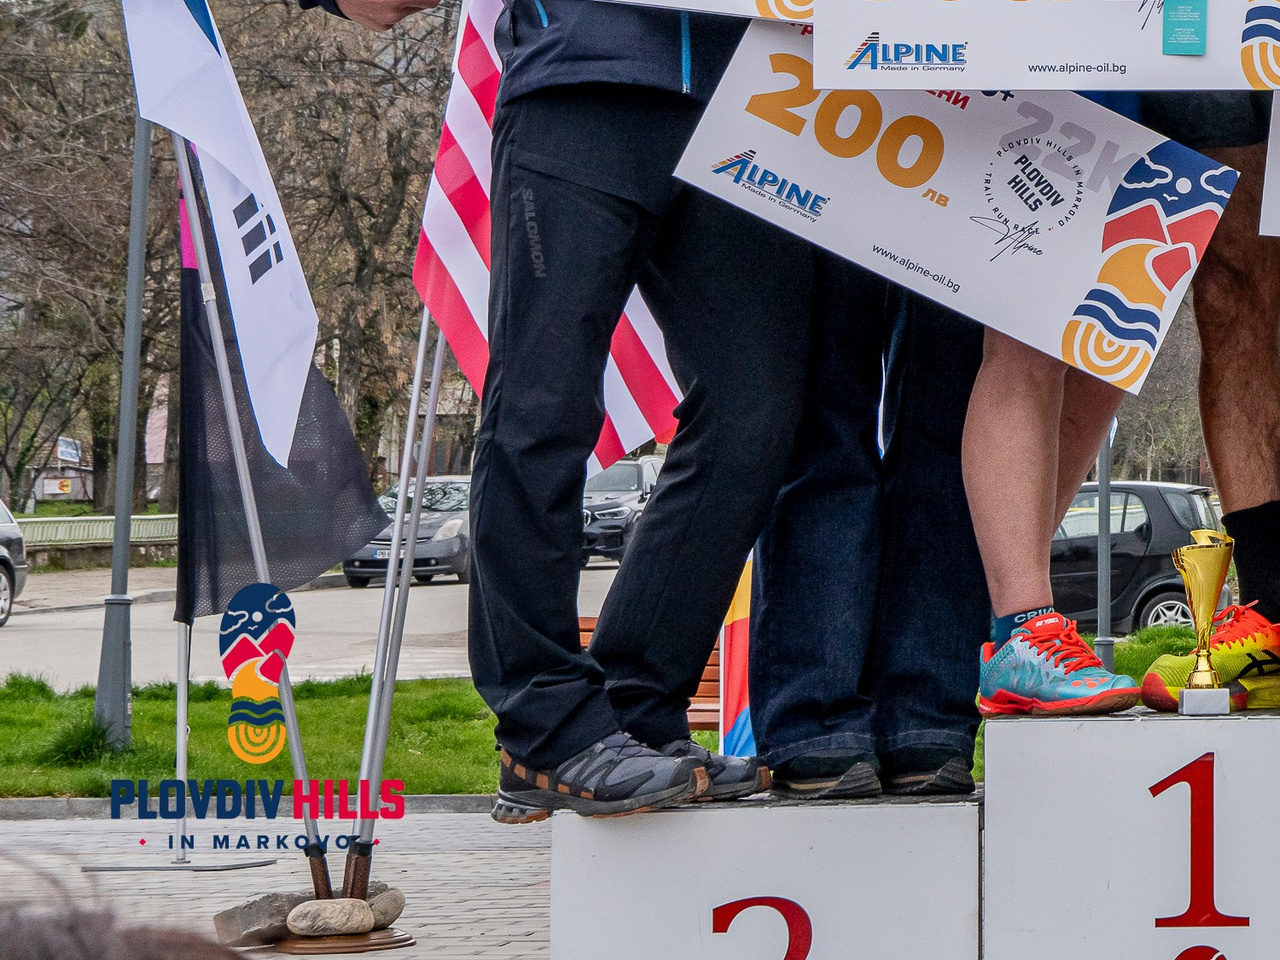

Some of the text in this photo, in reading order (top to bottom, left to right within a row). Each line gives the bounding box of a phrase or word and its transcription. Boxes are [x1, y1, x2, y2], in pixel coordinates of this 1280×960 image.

[844, 32, 969, 71] ALPINE
[922, 65, 966, 74] Germany
[1028, 61, 1127, 76] www.alpine-oil.bg
[744, 52, 950, 208] 200 лв
[711, 149, 829, 217] ALPINE
[741, 182, 766, 198] Made
[778, 200, 818, 223] Germany
[983, 172, 995, 204] TRAIL
[992, 206, 1010, 226] RUN
[996, 137, 1084, 227] PLOVDIV HILLS IN MARKOVO
[1007, 174, 1044, 213] HILLS
[1013, 154, 1066, 207] PLOVDIV
[521, 187, 547, 278] SALOMON
[872, 243, 961, 295] www.alpine-oil.bg
[1148, 751, 1251, 929] 1
